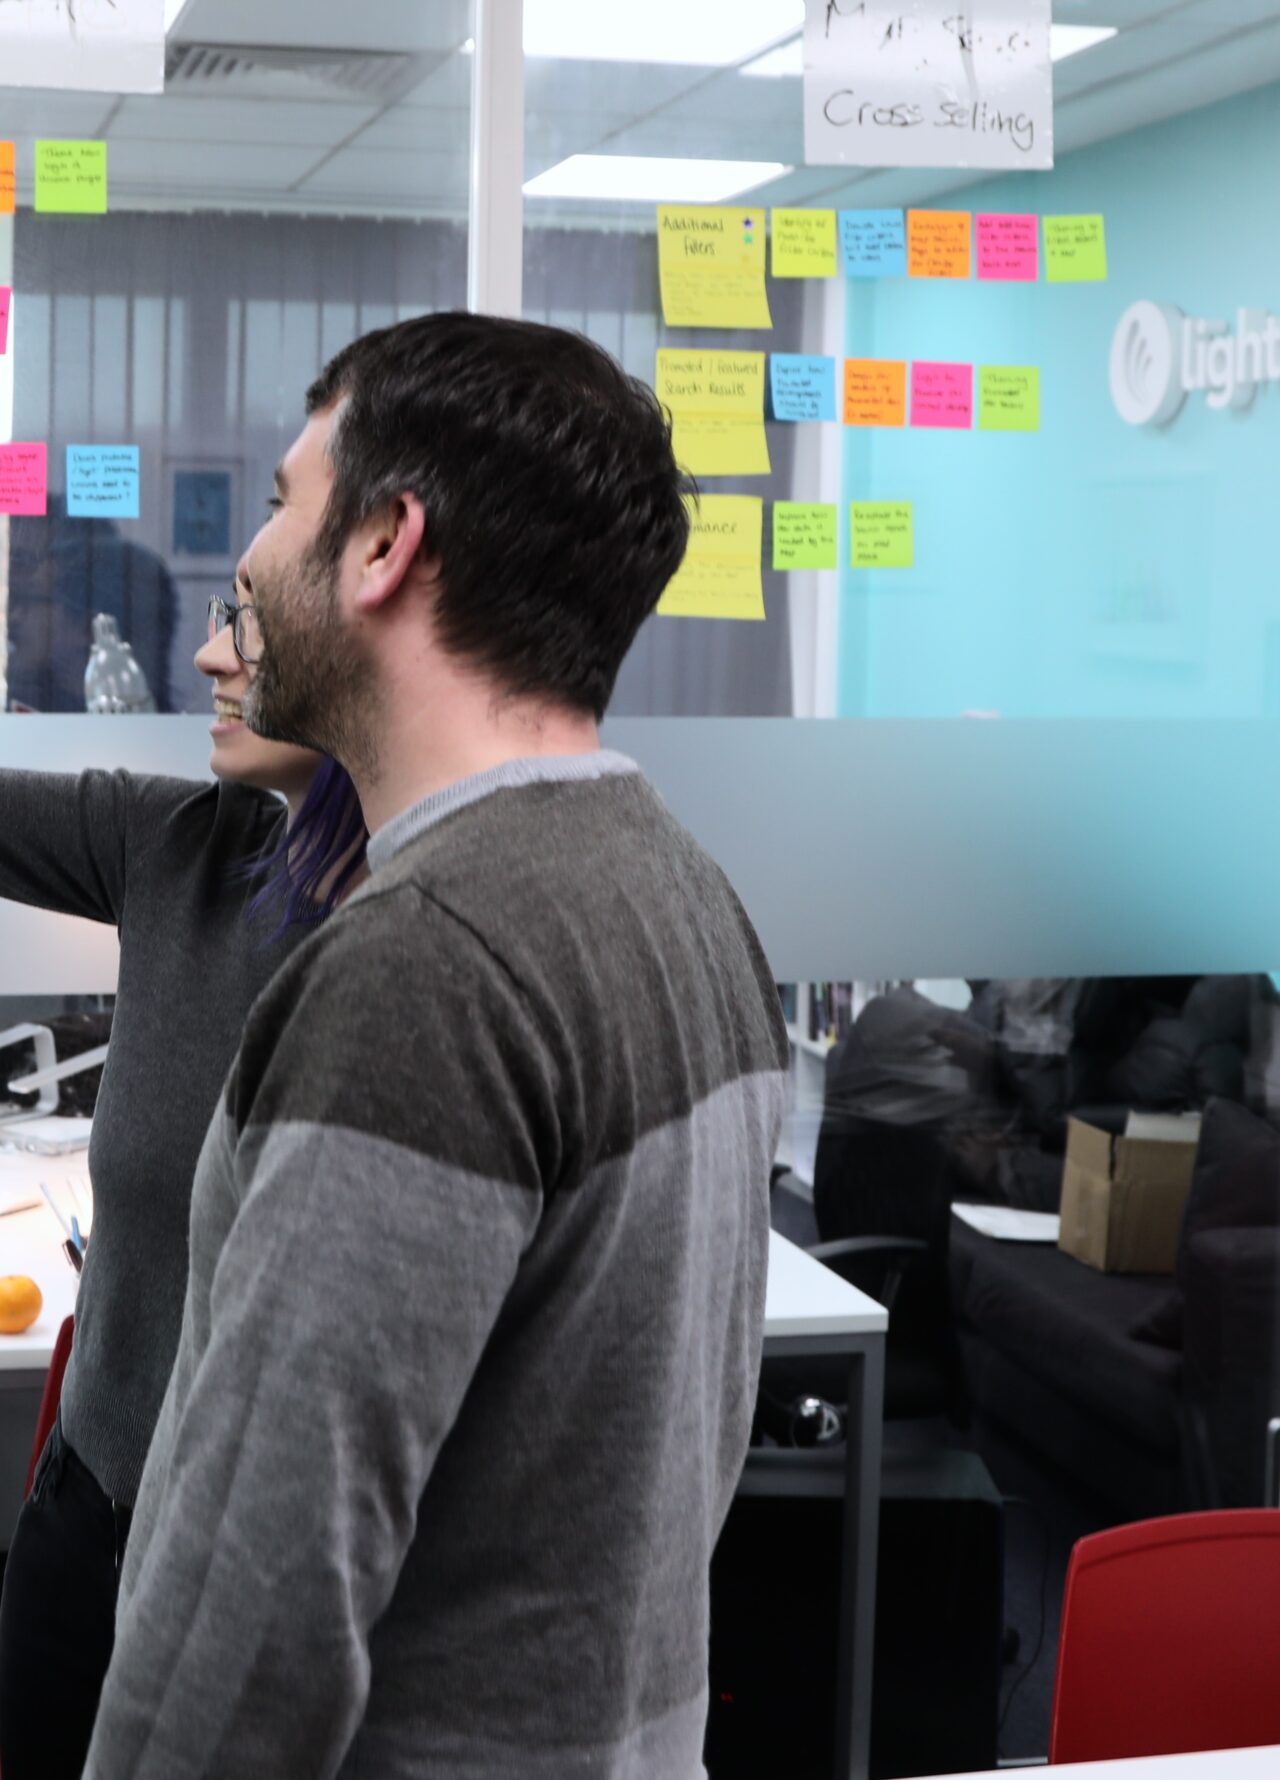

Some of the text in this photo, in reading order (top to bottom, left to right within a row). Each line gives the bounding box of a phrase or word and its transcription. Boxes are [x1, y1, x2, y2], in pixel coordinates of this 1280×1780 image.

[823, 88, 923, 128] Cross
[662, 214, 724, 233] Additional
[664, 381, 703, 397] Search
